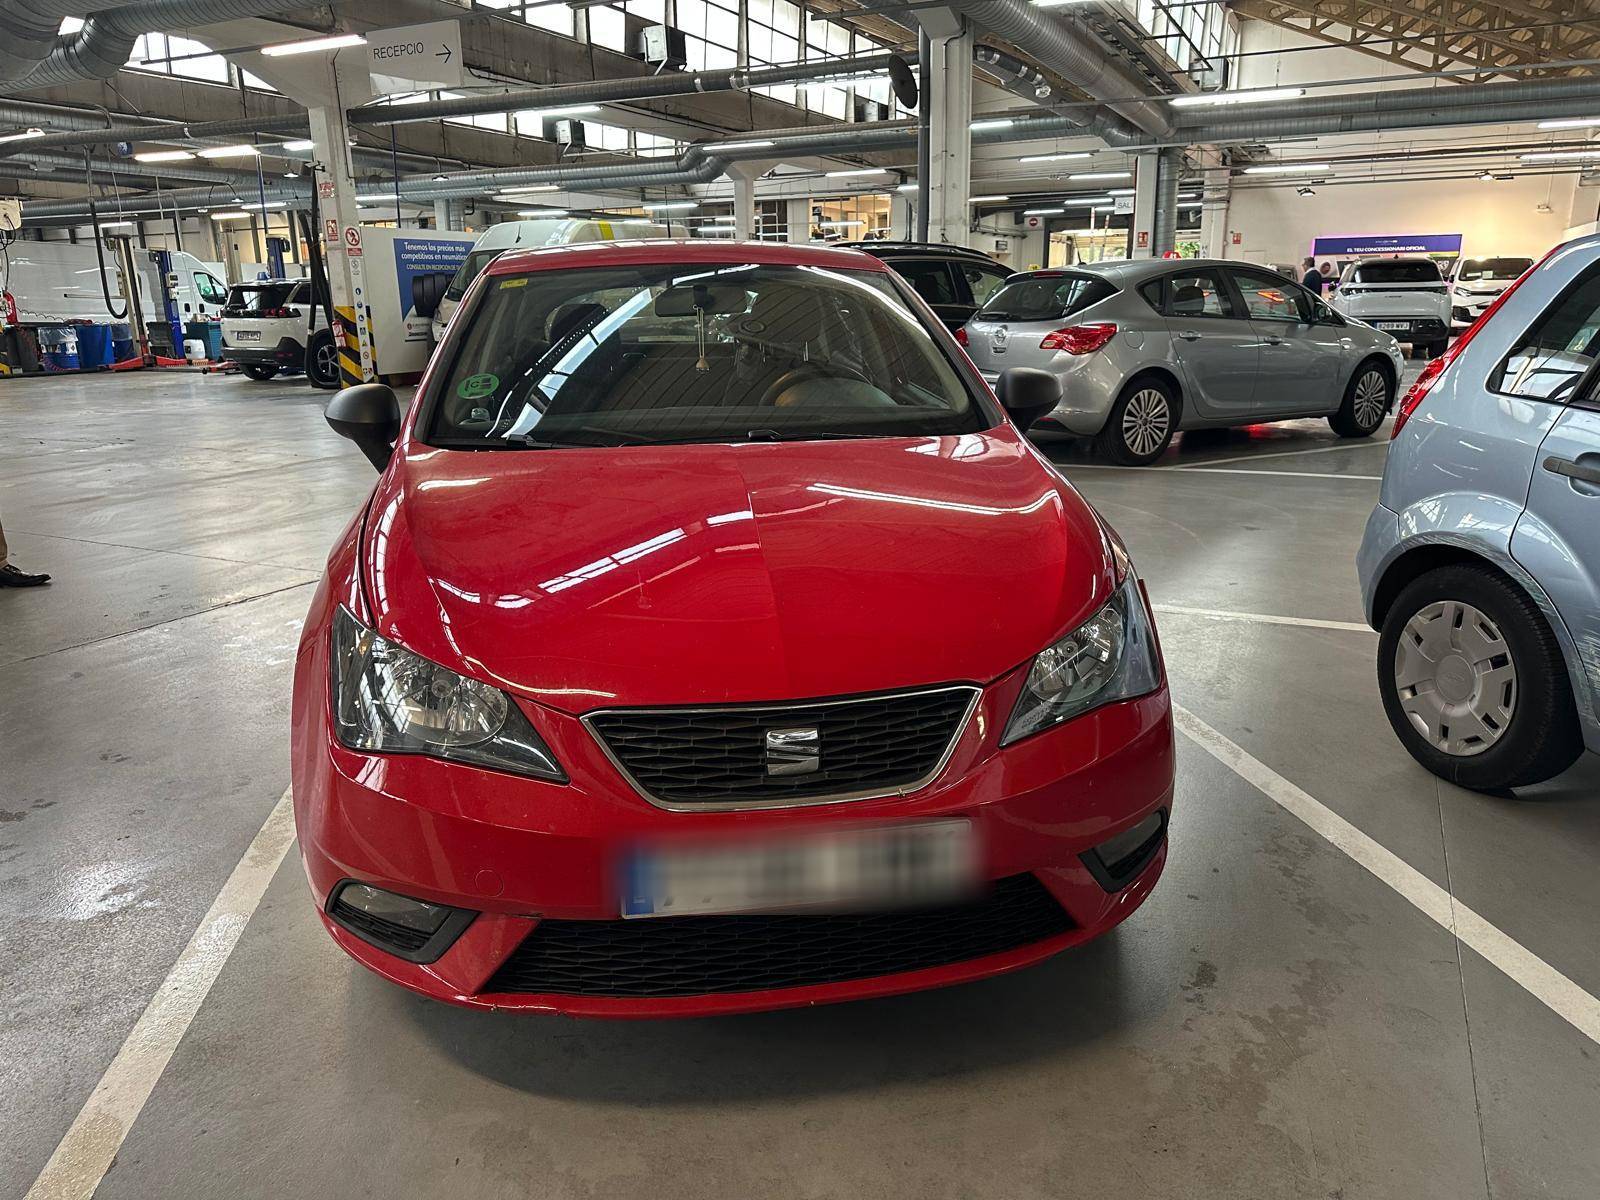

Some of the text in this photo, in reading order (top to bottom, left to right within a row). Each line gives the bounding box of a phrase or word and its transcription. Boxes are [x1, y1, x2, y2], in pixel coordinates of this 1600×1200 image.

[404, 242, 466, 253] Tenemos los precios más
[401, 252, 434, 262] competitivos
